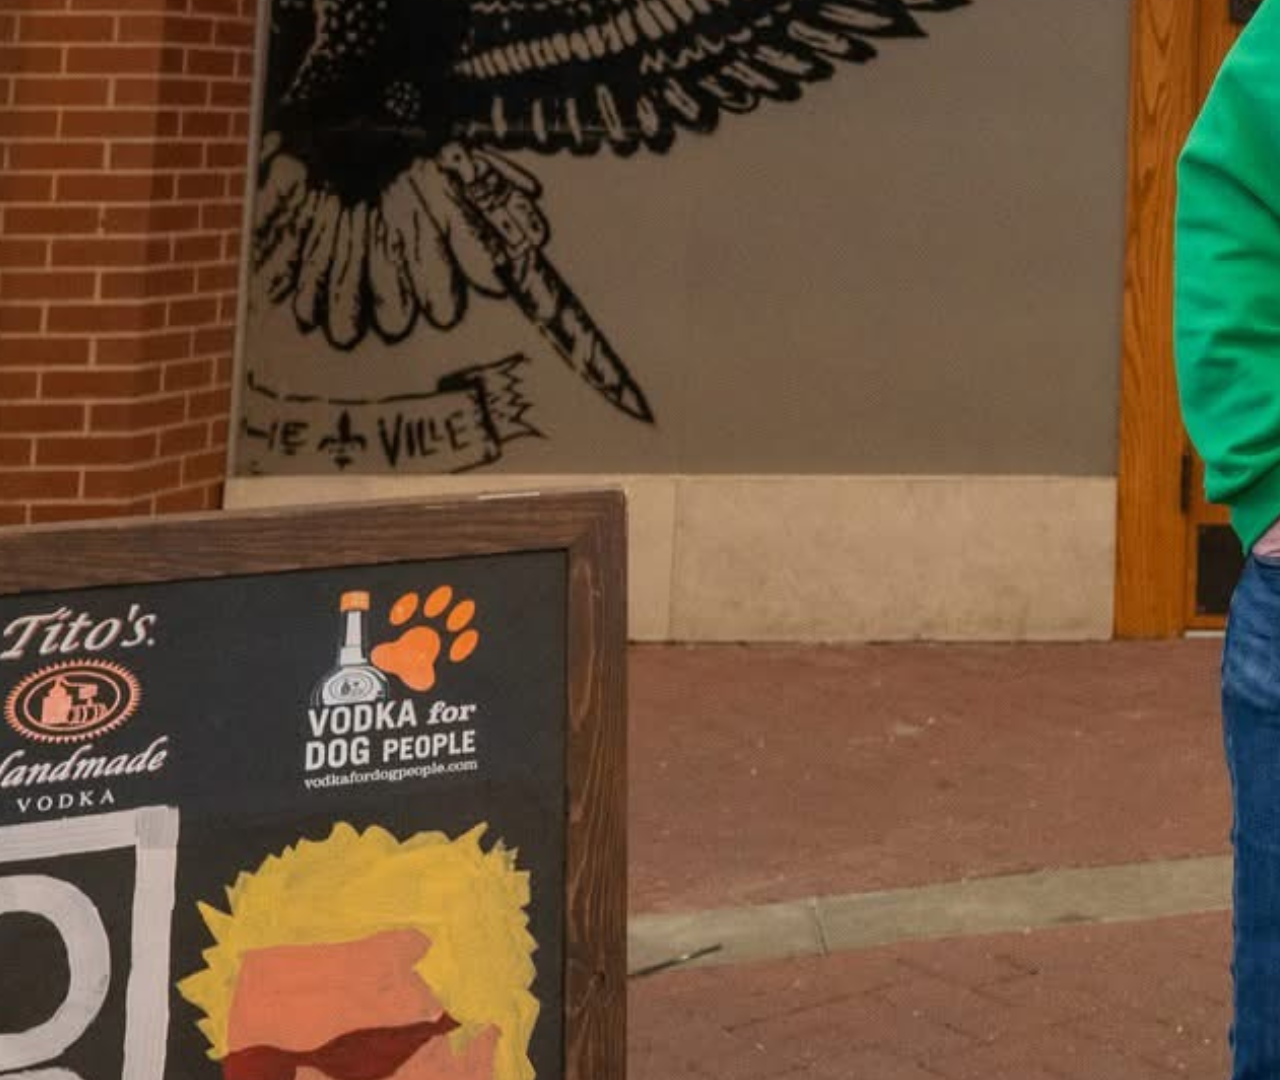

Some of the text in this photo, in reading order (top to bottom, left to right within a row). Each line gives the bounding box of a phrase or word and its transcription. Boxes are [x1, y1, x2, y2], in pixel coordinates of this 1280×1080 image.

[307, 698, 478, 738] VODKA for
[304, 729, 477, 771] DOG PEOPLE
[303, 760, 479, 790] vodkafordogpeople.com
[16, 788, 116, 814] VODKA
